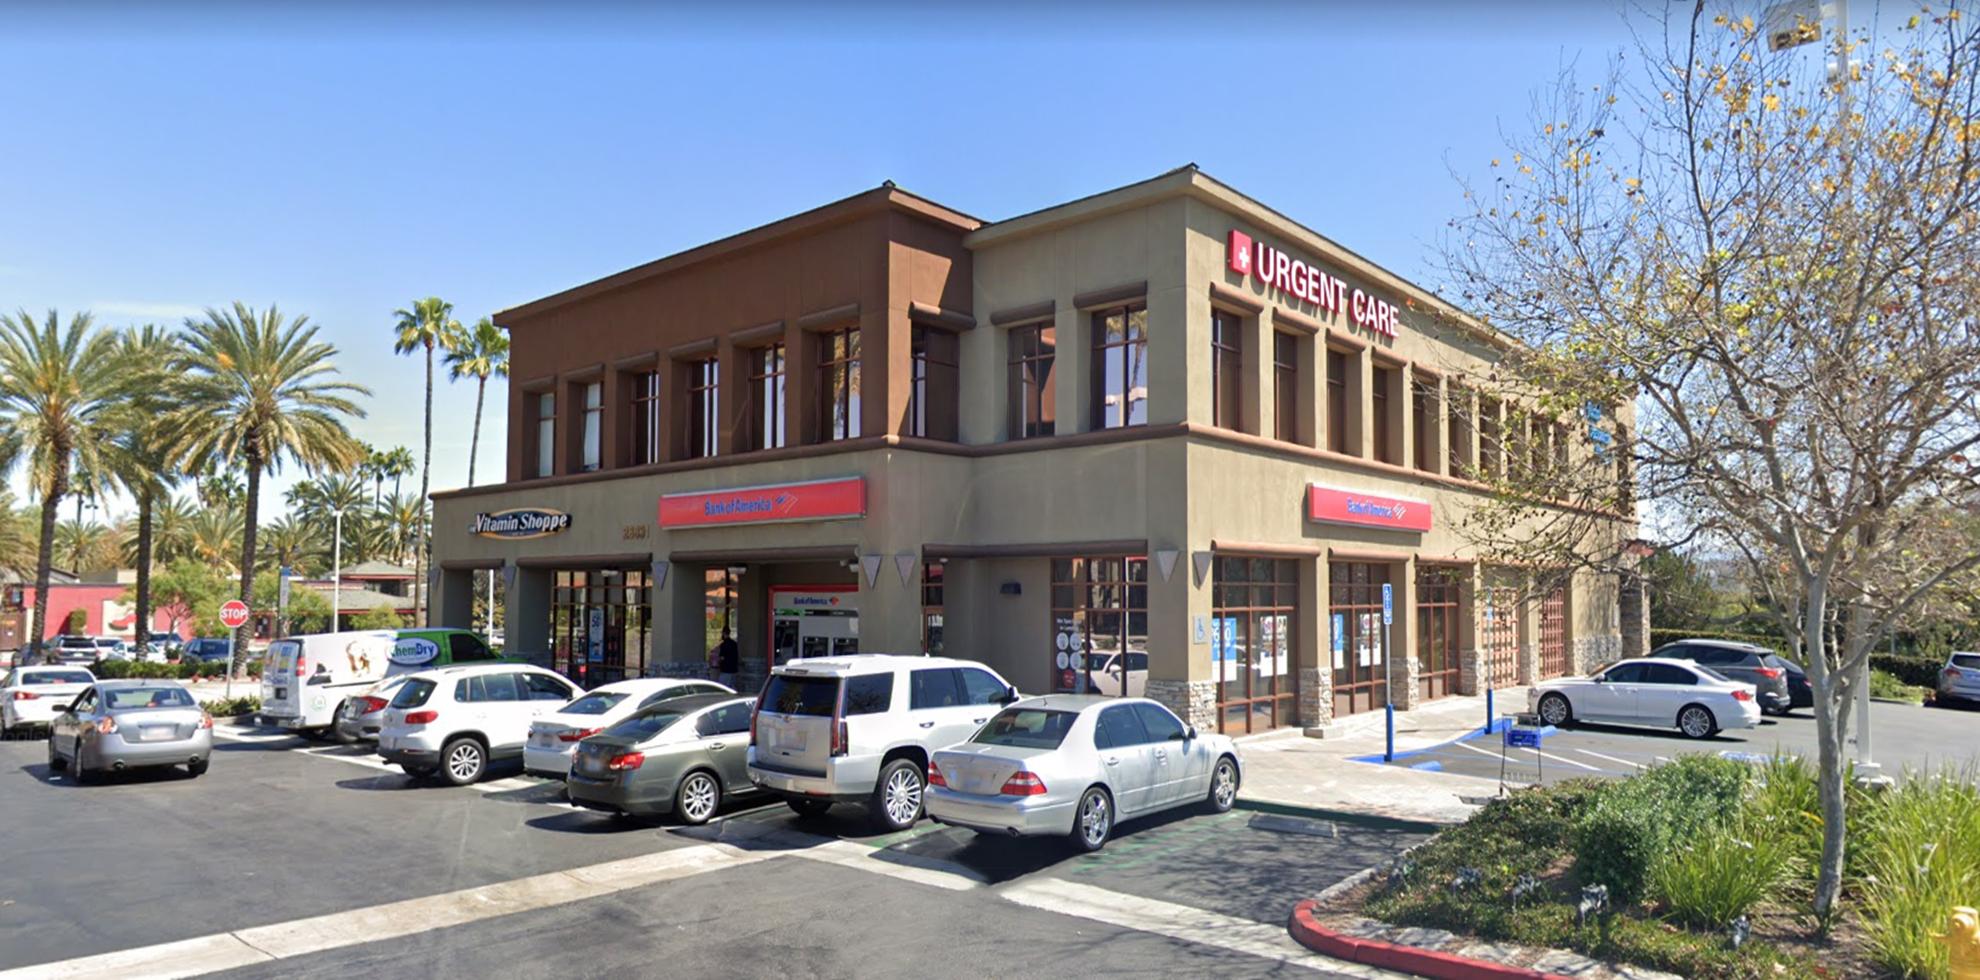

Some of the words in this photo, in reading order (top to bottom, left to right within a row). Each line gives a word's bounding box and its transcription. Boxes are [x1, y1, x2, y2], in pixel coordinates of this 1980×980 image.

[1257, 242, 1347, 313] URGENT
[1353, 289, 1400, 337] CARE
[476, 513, 518, 532] Vitamin
[519, 513, 568, 531] Shoppe
[220, 608, 248, 619] STOP
